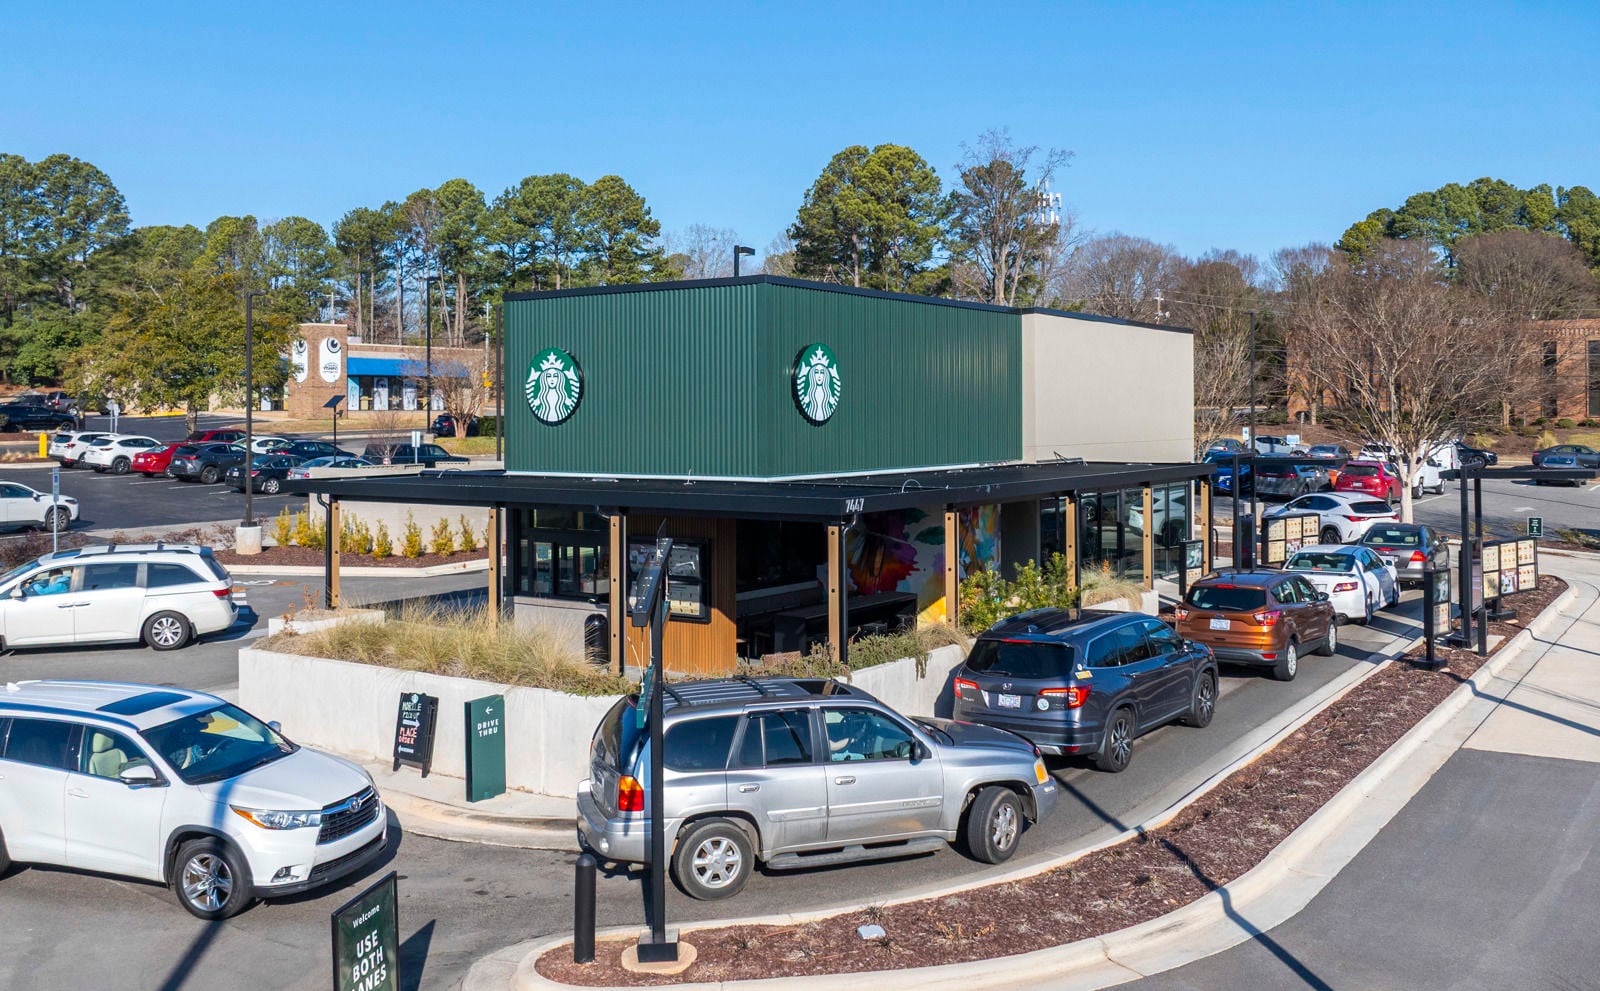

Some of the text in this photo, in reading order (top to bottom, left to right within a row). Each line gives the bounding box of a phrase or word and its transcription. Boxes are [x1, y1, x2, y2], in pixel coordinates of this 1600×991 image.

[477, 719, 499, 730] DRIVE
[400, 727, 417, 737] PLACE
[479, 727, 498, 737] THRU
[398, 736, 414, 744] ORDER
[356, 929, 379, 958] USE
[352, 946, 384, 983] BOTH
[351, 964, 387, 991] ANES
